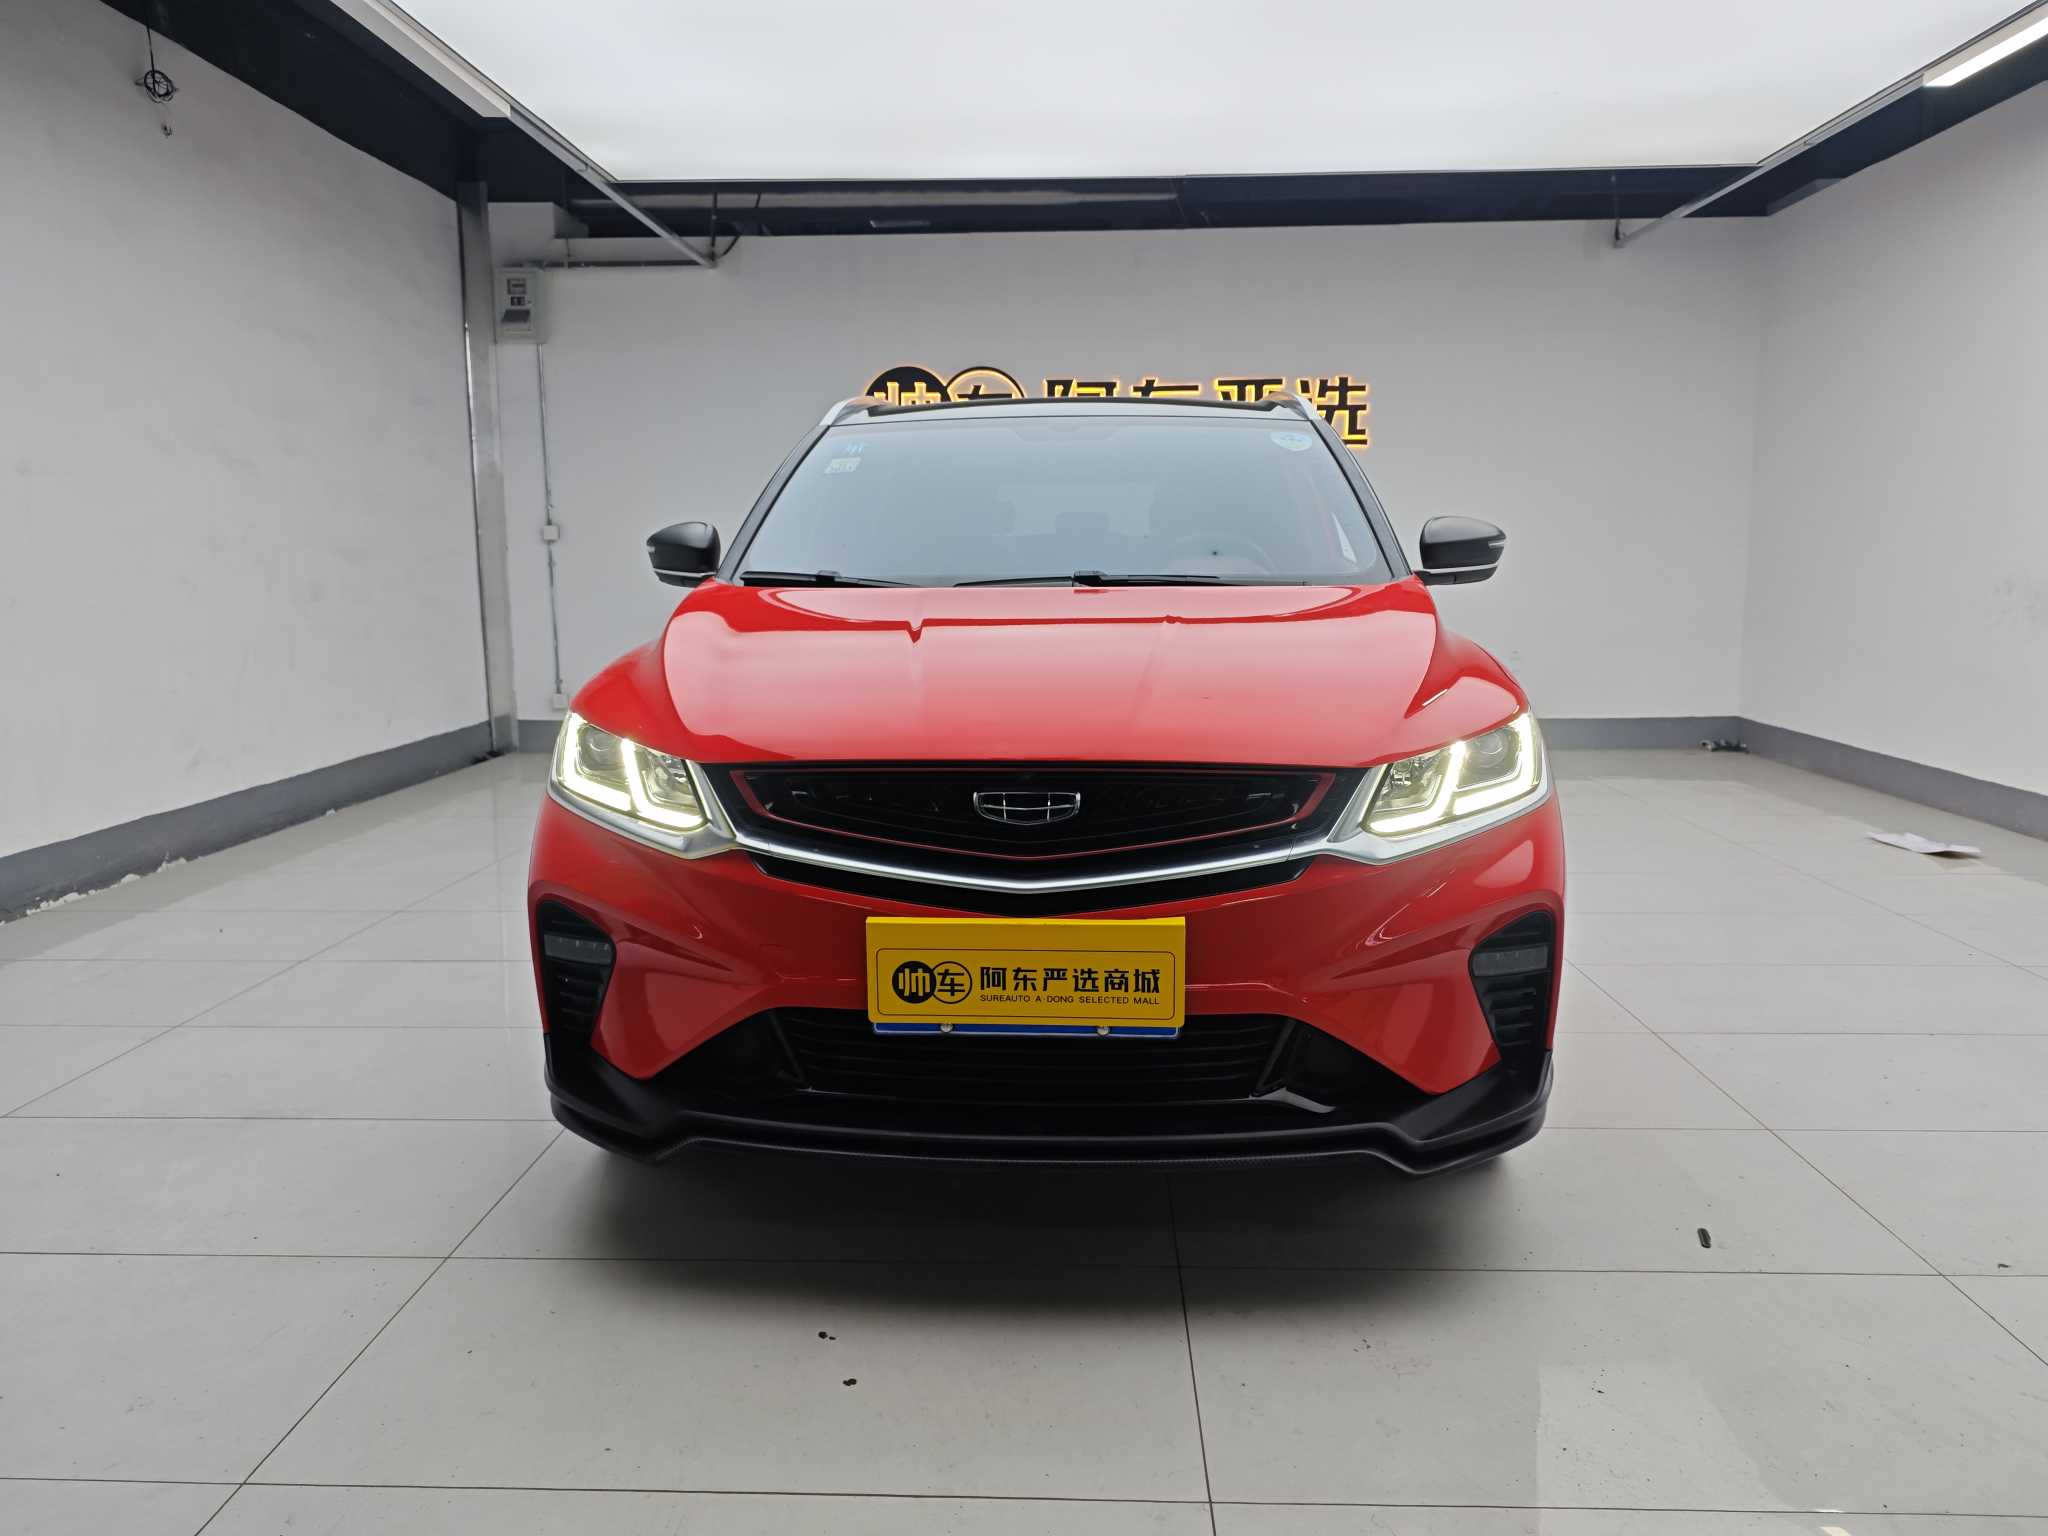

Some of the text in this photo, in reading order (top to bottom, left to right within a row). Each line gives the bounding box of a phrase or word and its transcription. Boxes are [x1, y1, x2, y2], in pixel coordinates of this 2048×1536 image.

[980, 966, 1160, 994] 阿东严选商城
[980, 994, 1031, 1003] SUREAUTO
[1079, 996, 1129, 1005] SELECTED
[1133, 997, 1160, 1006] MALL
